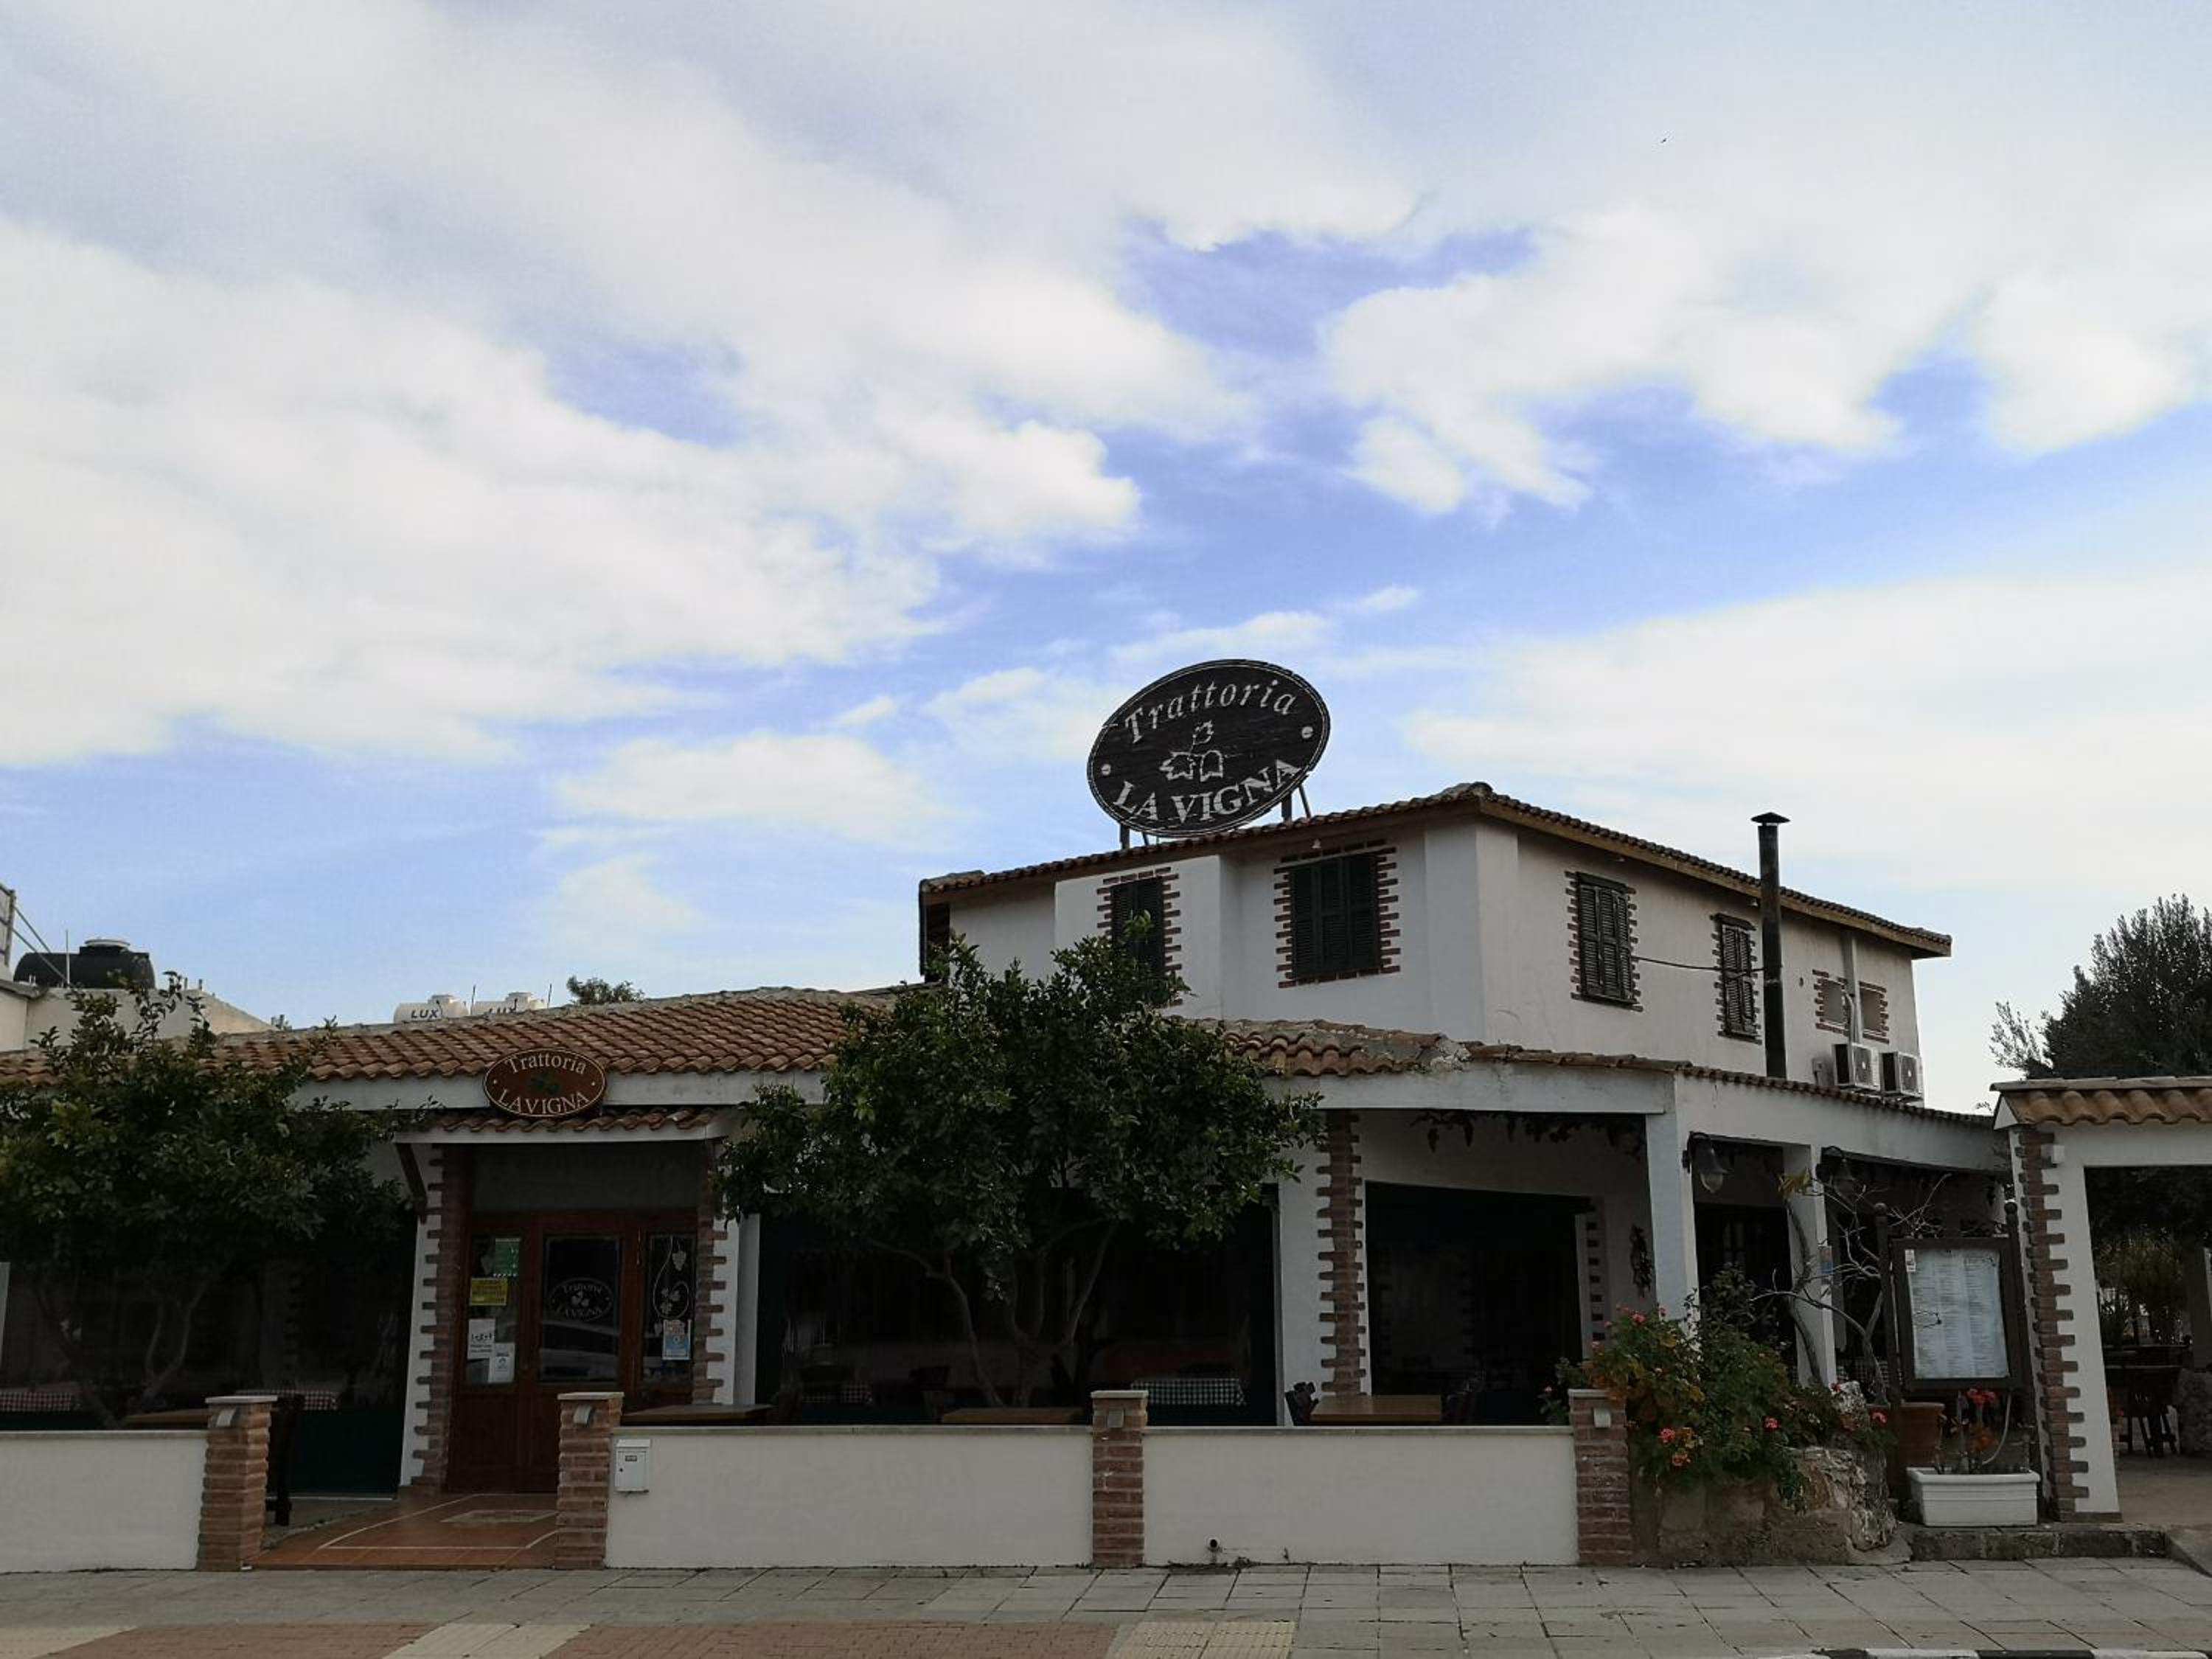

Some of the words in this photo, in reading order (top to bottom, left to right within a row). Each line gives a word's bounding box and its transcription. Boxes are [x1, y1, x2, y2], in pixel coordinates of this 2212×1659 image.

[1124, 679, 1296, 743] Trattoria
[1113, 780, 1158, 821] LA
[1170, 759, 1302, 824] VIGNA
[411, 1009, 439, 1018] LUX
[505, 1052, 587, 1074] Trattoria
[498, 1088, 521, 1113] LA
[525, 1091, 589, 1114] VIGNA
